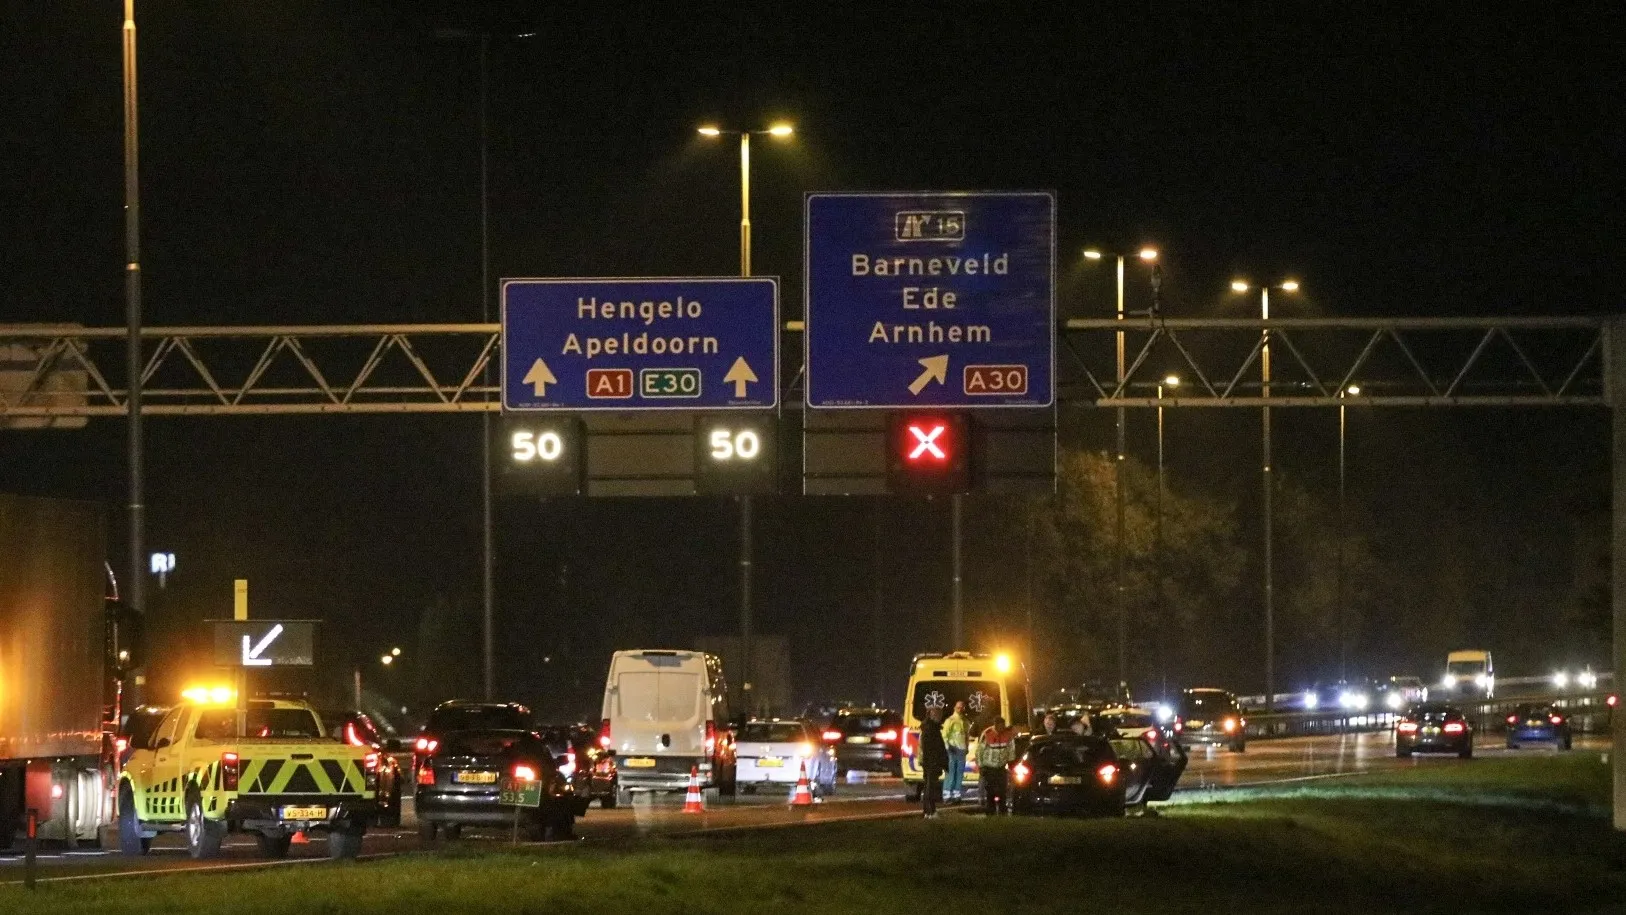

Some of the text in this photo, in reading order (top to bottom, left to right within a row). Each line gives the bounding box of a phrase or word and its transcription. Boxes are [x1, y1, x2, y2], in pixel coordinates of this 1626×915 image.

[936, 217, 960, 233] 15
[851, 252, 1009, 276] Barneveld
[577, 296, 703, 324] Hengelo
[902, 286, 957, 310] Ede
[868, 320, 992, 344] Arnhem
[562, 332, 719, 359] Apeldoorn
[594, 374, 624, 392] A1
[645, 373, 696, 392] E30
[968, 370, 1022, 390] A30
[511, 431, 563, 462] 50
[709, 429, 760, 460] 50
